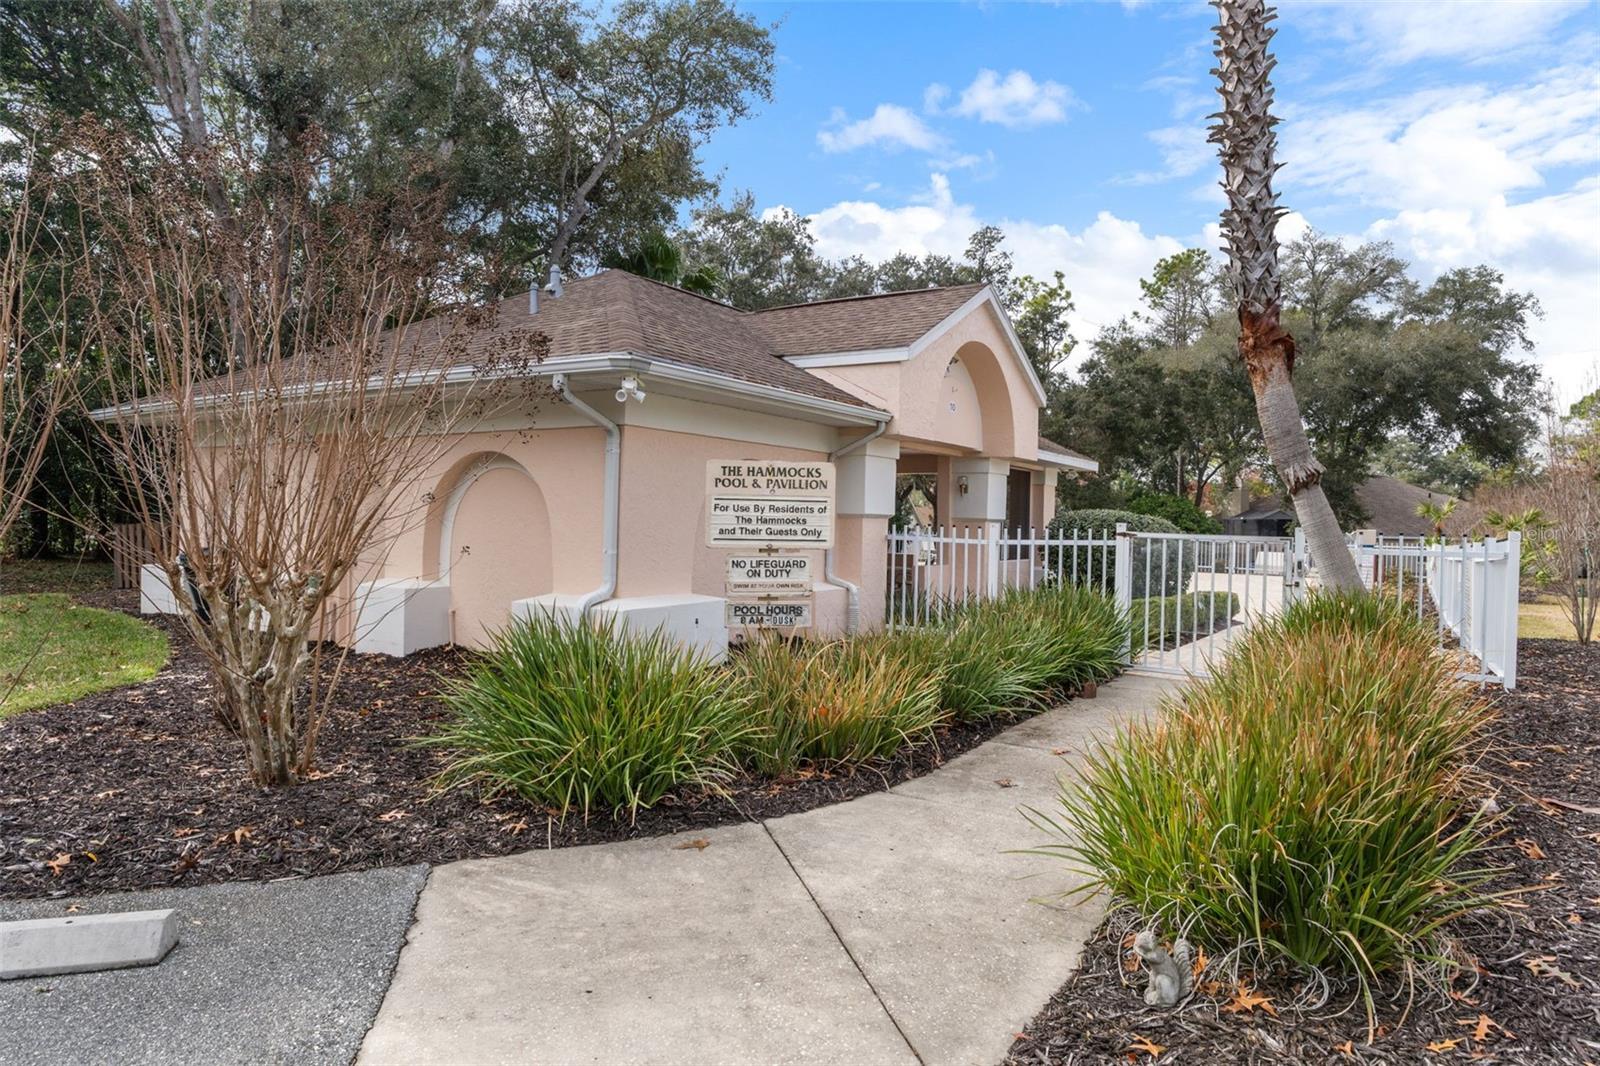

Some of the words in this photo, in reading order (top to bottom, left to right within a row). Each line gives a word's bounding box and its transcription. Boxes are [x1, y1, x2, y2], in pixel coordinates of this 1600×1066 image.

[721, 466, 743, 476] THE
[747, 466, 822, 478] HAMMOCKS
[714, 478, 748, 489] POOL
[752, 478, 761, 489] &
[766, 479, 828, 490] PAVILLION
[713, 504, 729, 512] For
[733, 504, 750, 513] Use
[753, 504, 765, 514] By
[769, 505, 814, 514] Residents
[818, 505, 827, 514] of
[735, 516, 752, 524] The
[756, 516, 807, 525] Hammocks
[718, 527, 736, 535] and
[739, 527, 762, 535] Their
[765, 527, 798, 536] Guests
[801, 528, 822, 538] Only
[731, 559, 746, 569] NO
[750, 559, 807, 569] LIFEGUARD
[746, 569, 761, 578] ON
[765, 569, 792, 578] DUTY
[734, 605, 764, 615] POOL
[766, 605, 803, 615] HOURS
[749, 616, 763, 625] AM
